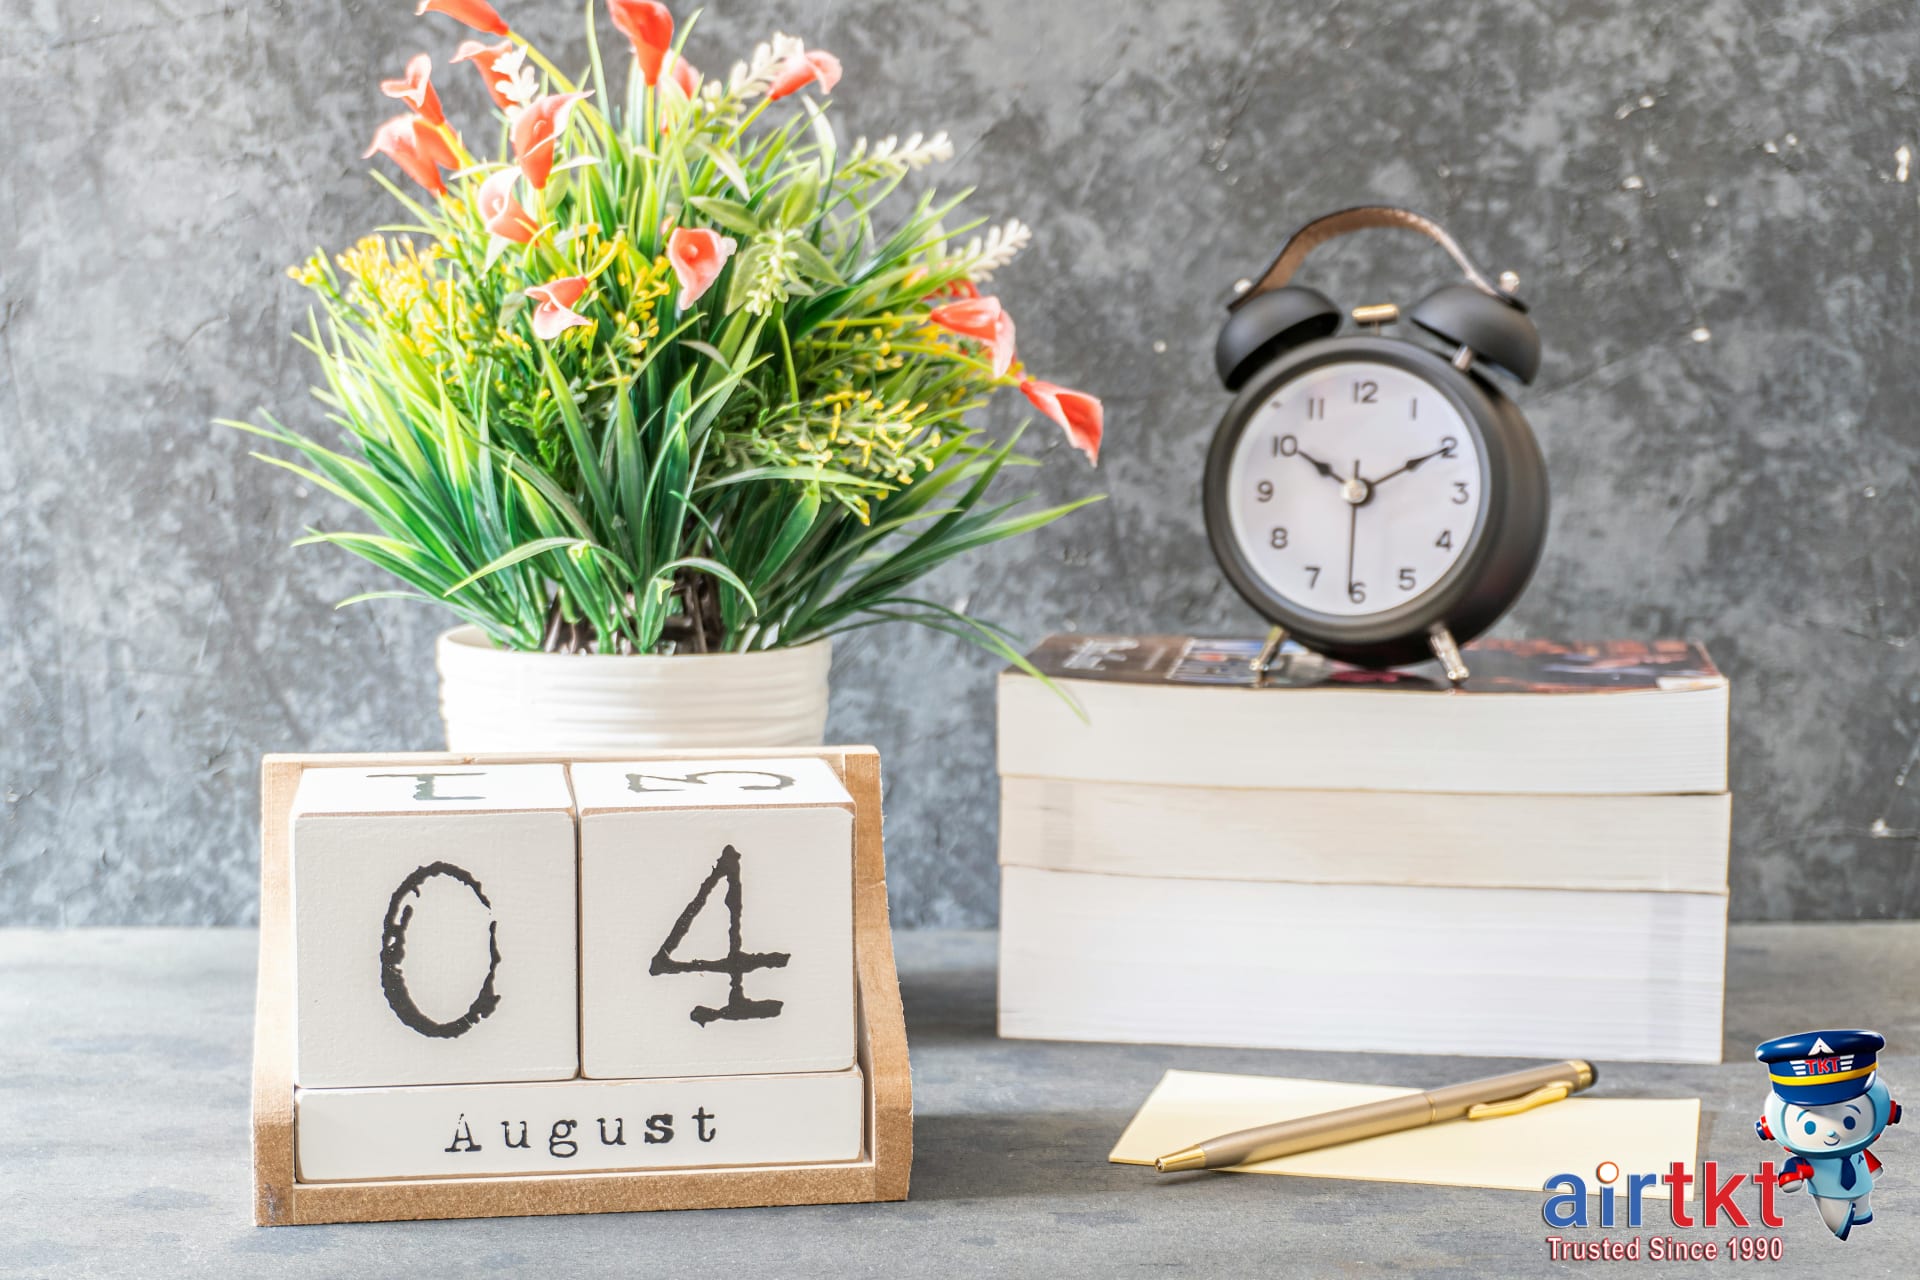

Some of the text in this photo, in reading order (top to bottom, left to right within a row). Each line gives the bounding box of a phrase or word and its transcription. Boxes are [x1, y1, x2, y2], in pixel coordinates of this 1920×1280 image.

[1353, 381, 1379, 403] 12
[1307, 397, 1325, 420] 11
[1272, 435, 1299, 458] 10
[1440, 436, 1458, 459] 2
[1257, 481, 1274, 503] 9
[1451, 482, 1470, 505] 3
[1269, 526, 1289, 550] 8
[1434, 529, 1453, 551] 4
[1304, 566, 1321, 589] 7
[1398, 568, 1417, 591] 5
[1349, 581, 1367, 604] 6
[444, 1106, 717, 1159] August
